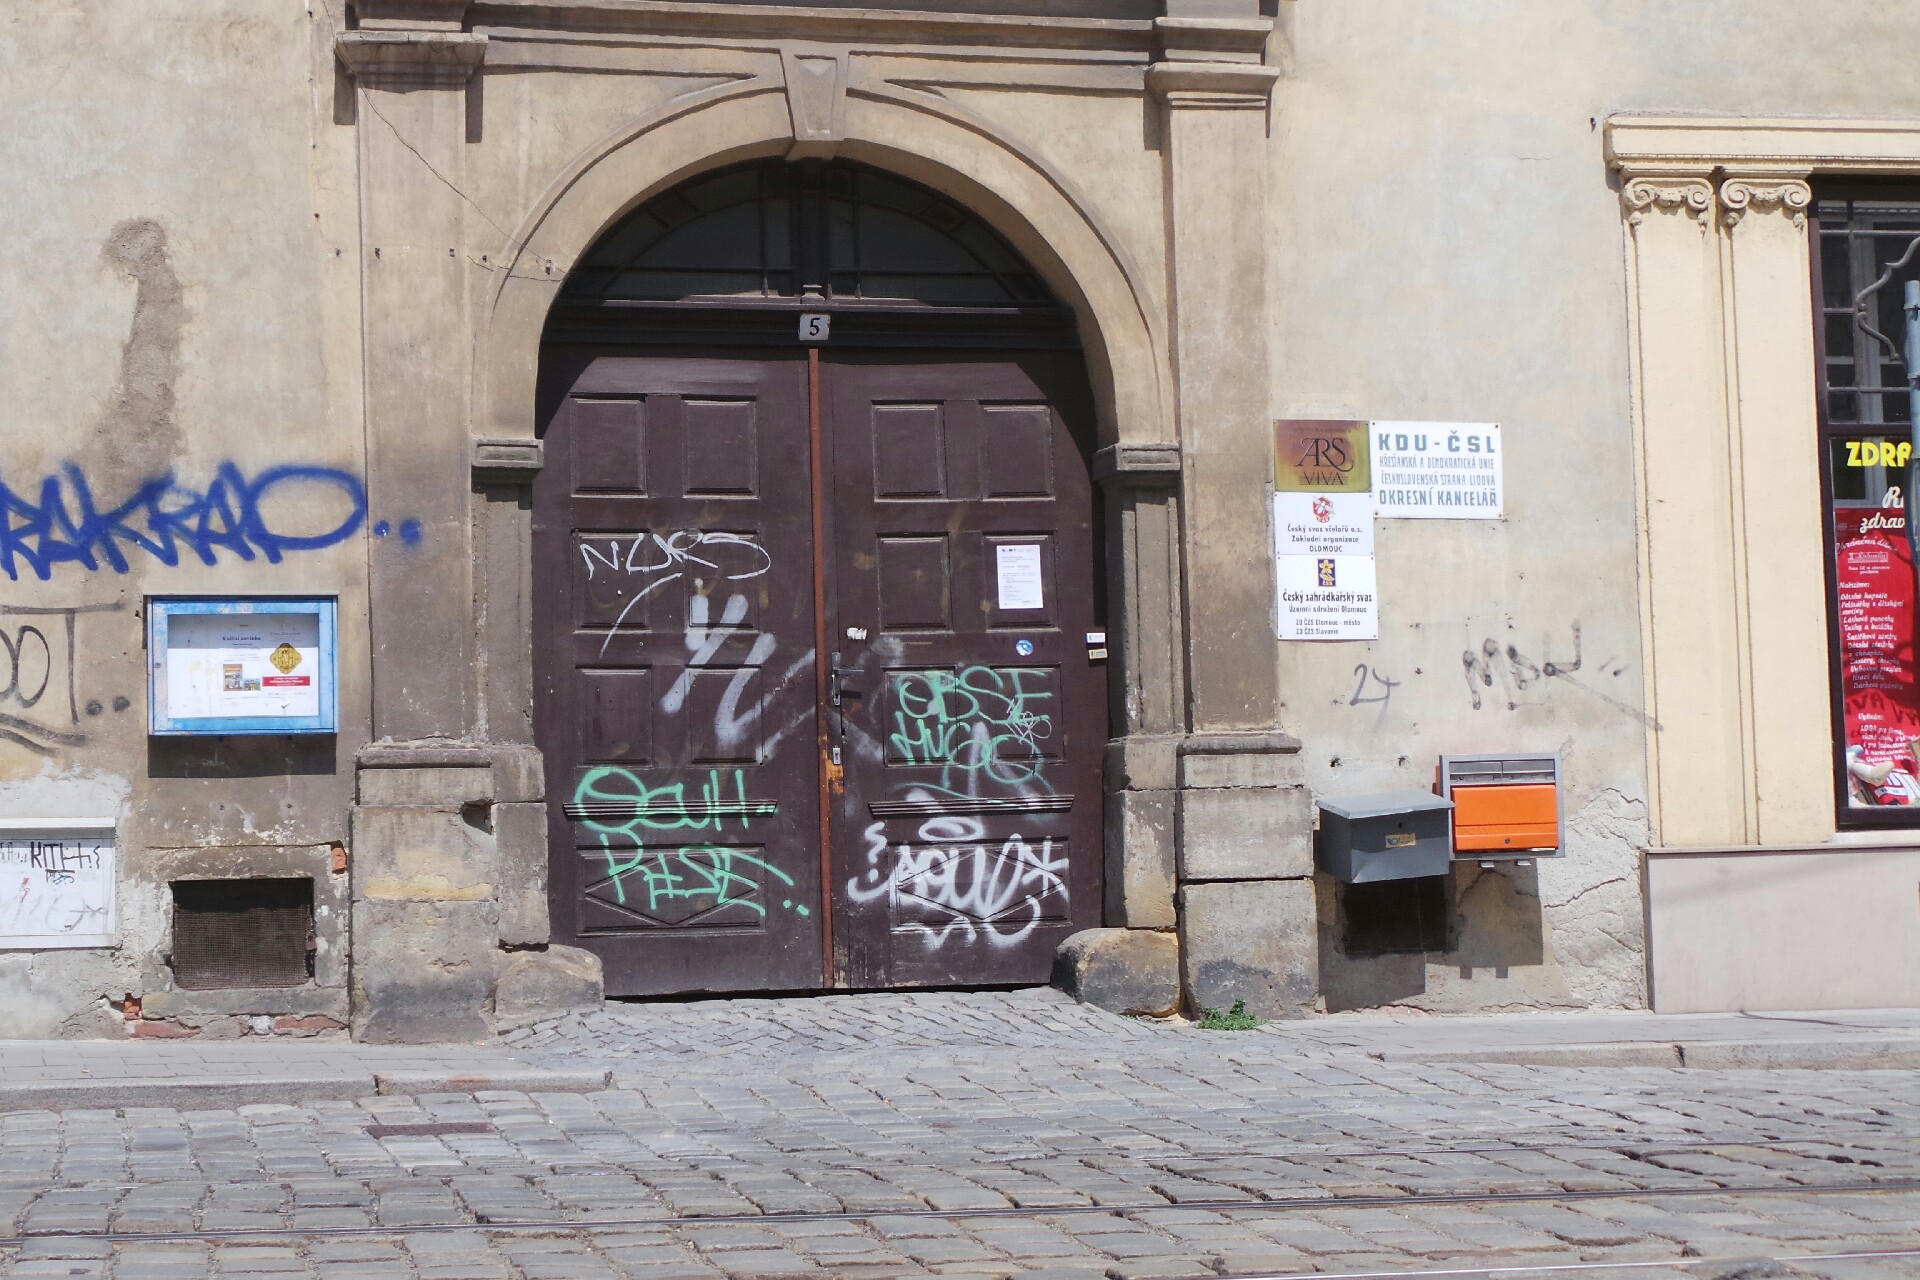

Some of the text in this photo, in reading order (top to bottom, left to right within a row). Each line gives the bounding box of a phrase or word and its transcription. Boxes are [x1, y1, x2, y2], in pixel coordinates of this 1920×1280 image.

[809, 317, 820, 336] 5
[1294, 437, 1354, 472] ARS
[1420, 457, 1425, 468] A
[1428, 455, 1476, 469] DEMOKRATICKÁ
[1479, 458, 1495, 469] UNIE
[1304, 472, 1344, 485] VIVA
[1381, 470, 1496, 486] ČESKOSLOVENSKÁ STRANA LIDOVÁ
[1379, 486, 1498, 507] OKRESNÍ KANCELÁŘ
[1287, 523, 1306, 533] Český
[1291, 535, 1359, 544] Základní organizace
[1309, 545, 1343, 553] OLOMOUC
[1282, 588, 1372, 604] Český zahrádkářský svaz
[1313, 604, 1340, 612] sdružení
[1341, 605, 1367, 613] Olomouc
